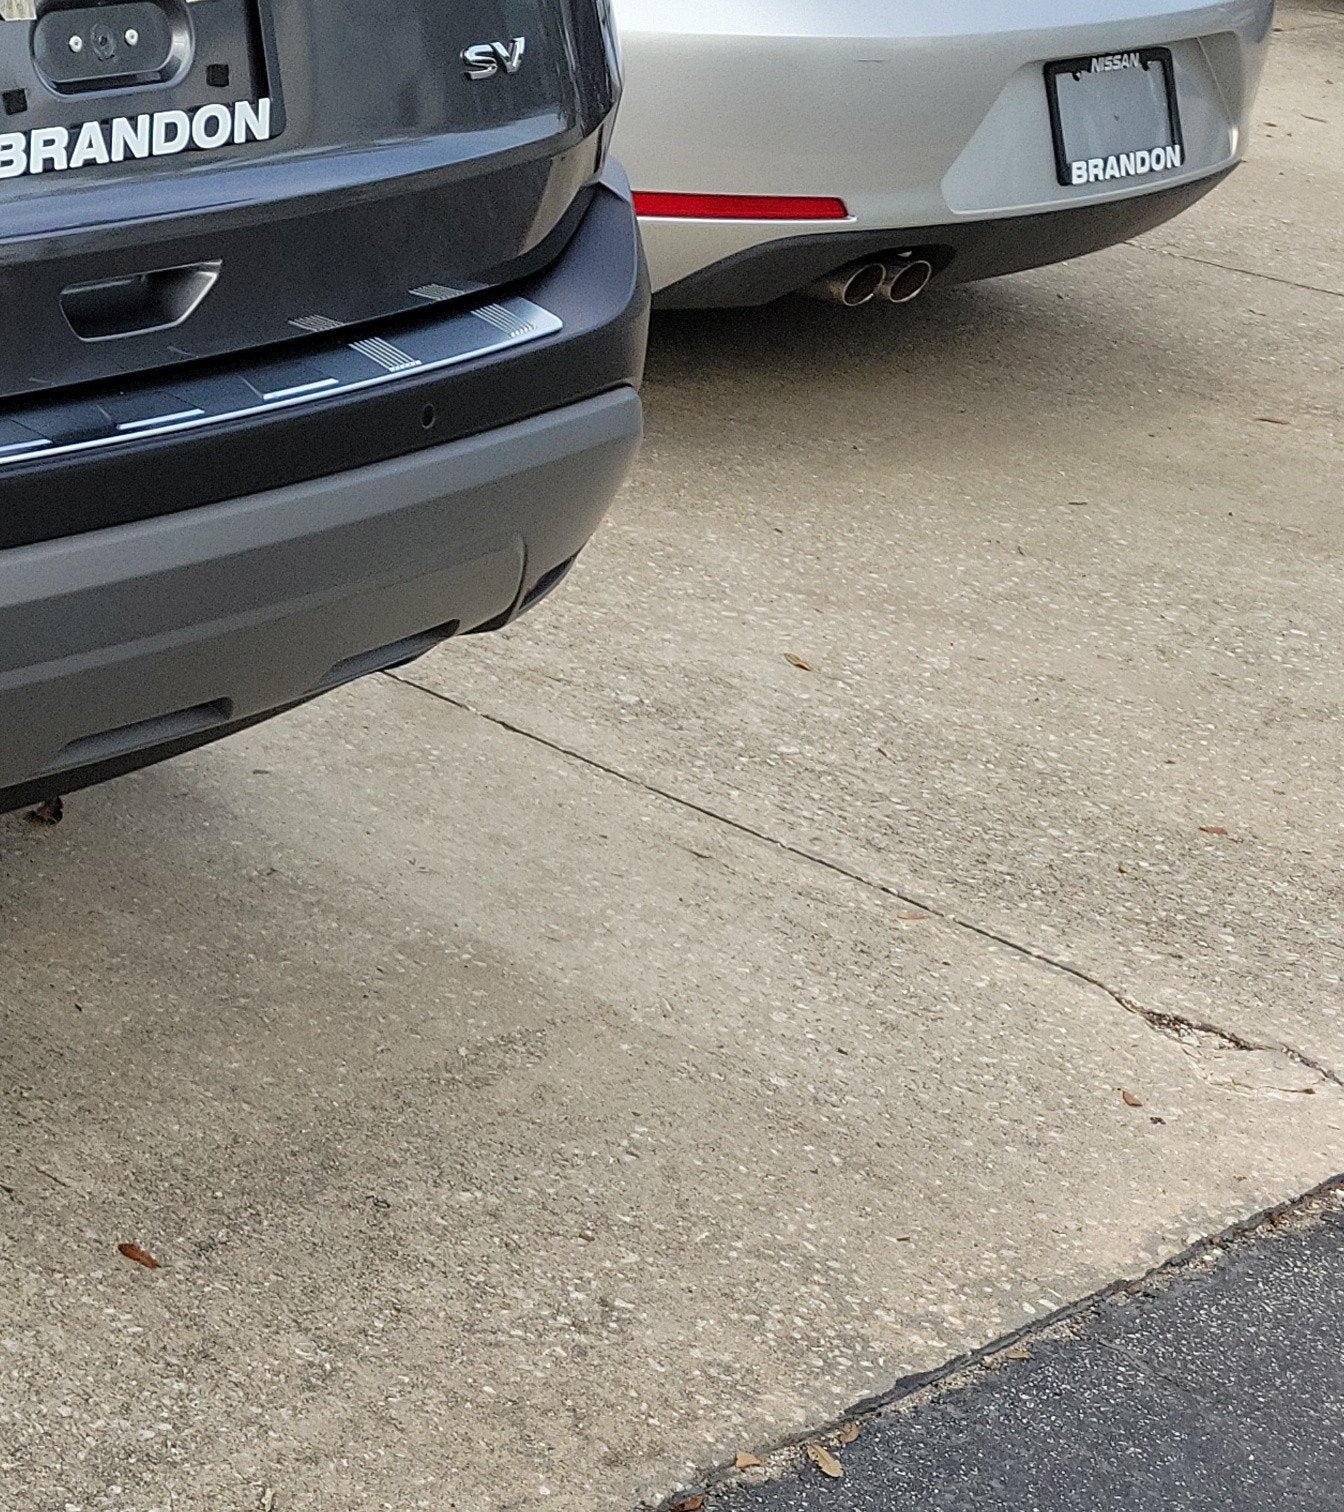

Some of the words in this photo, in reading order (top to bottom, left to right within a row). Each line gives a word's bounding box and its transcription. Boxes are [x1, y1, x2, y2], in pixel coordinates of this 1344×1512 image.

[459, 36, 525, 81] SV
[1091, 52, 1141, 73] NISSAN
[1072, 144, 1181, 185] BRANDON
